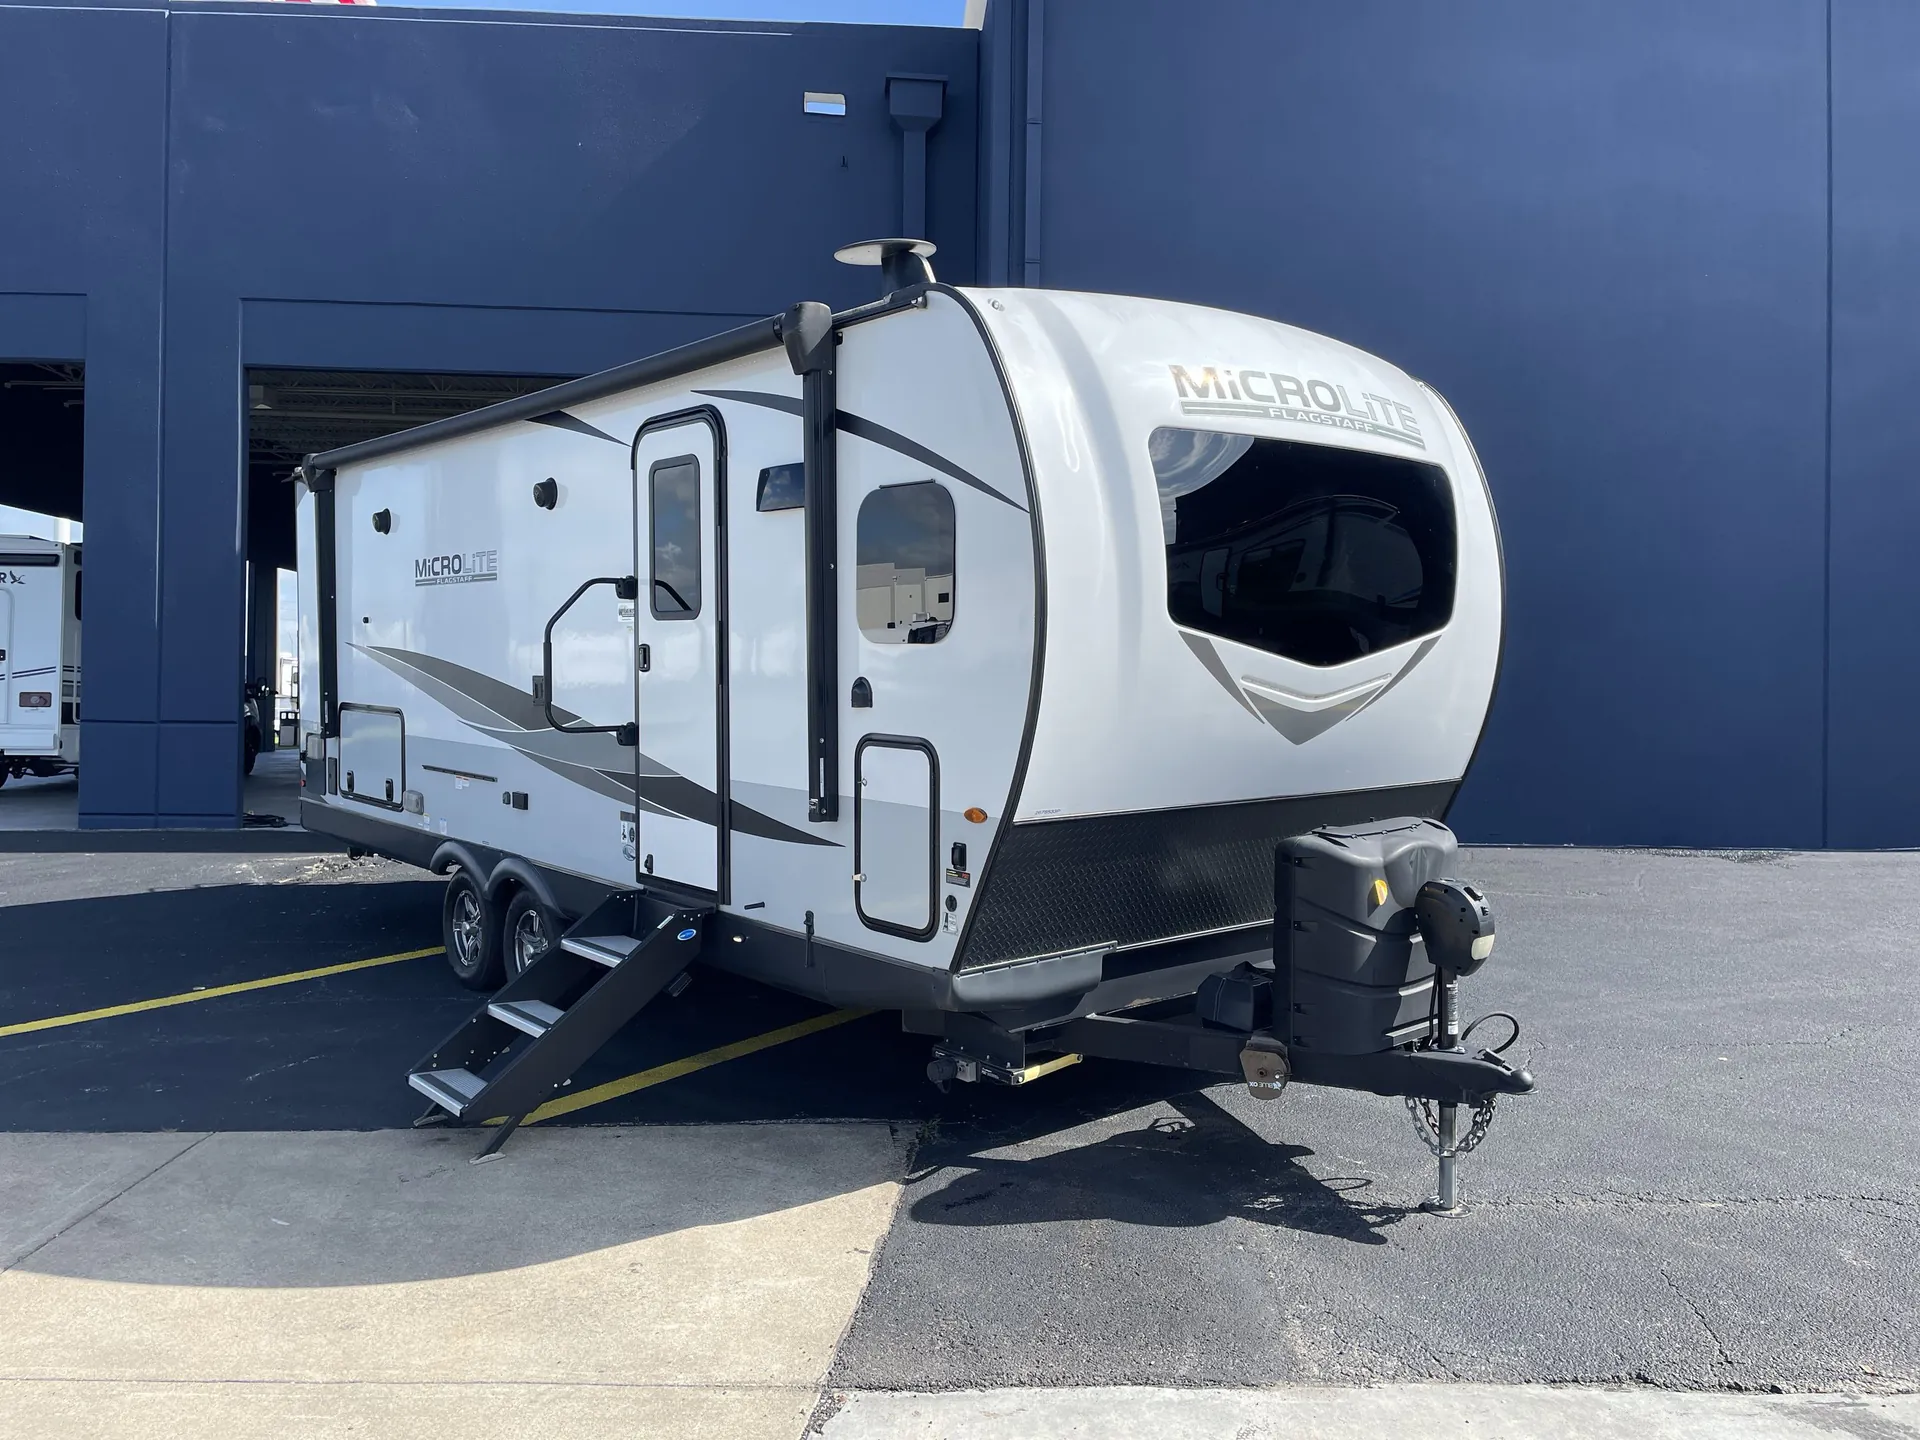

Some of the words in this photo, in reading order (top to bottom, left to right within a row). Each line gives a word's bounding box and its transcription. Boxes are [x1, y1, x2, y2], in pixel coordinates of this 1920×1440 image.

[1269, 407, 1375, 432] FLAGSTAFF
[436, 575, 473, 585] FLAGSTAFF
[1258, 1081, 1273, 1089] BLUE
